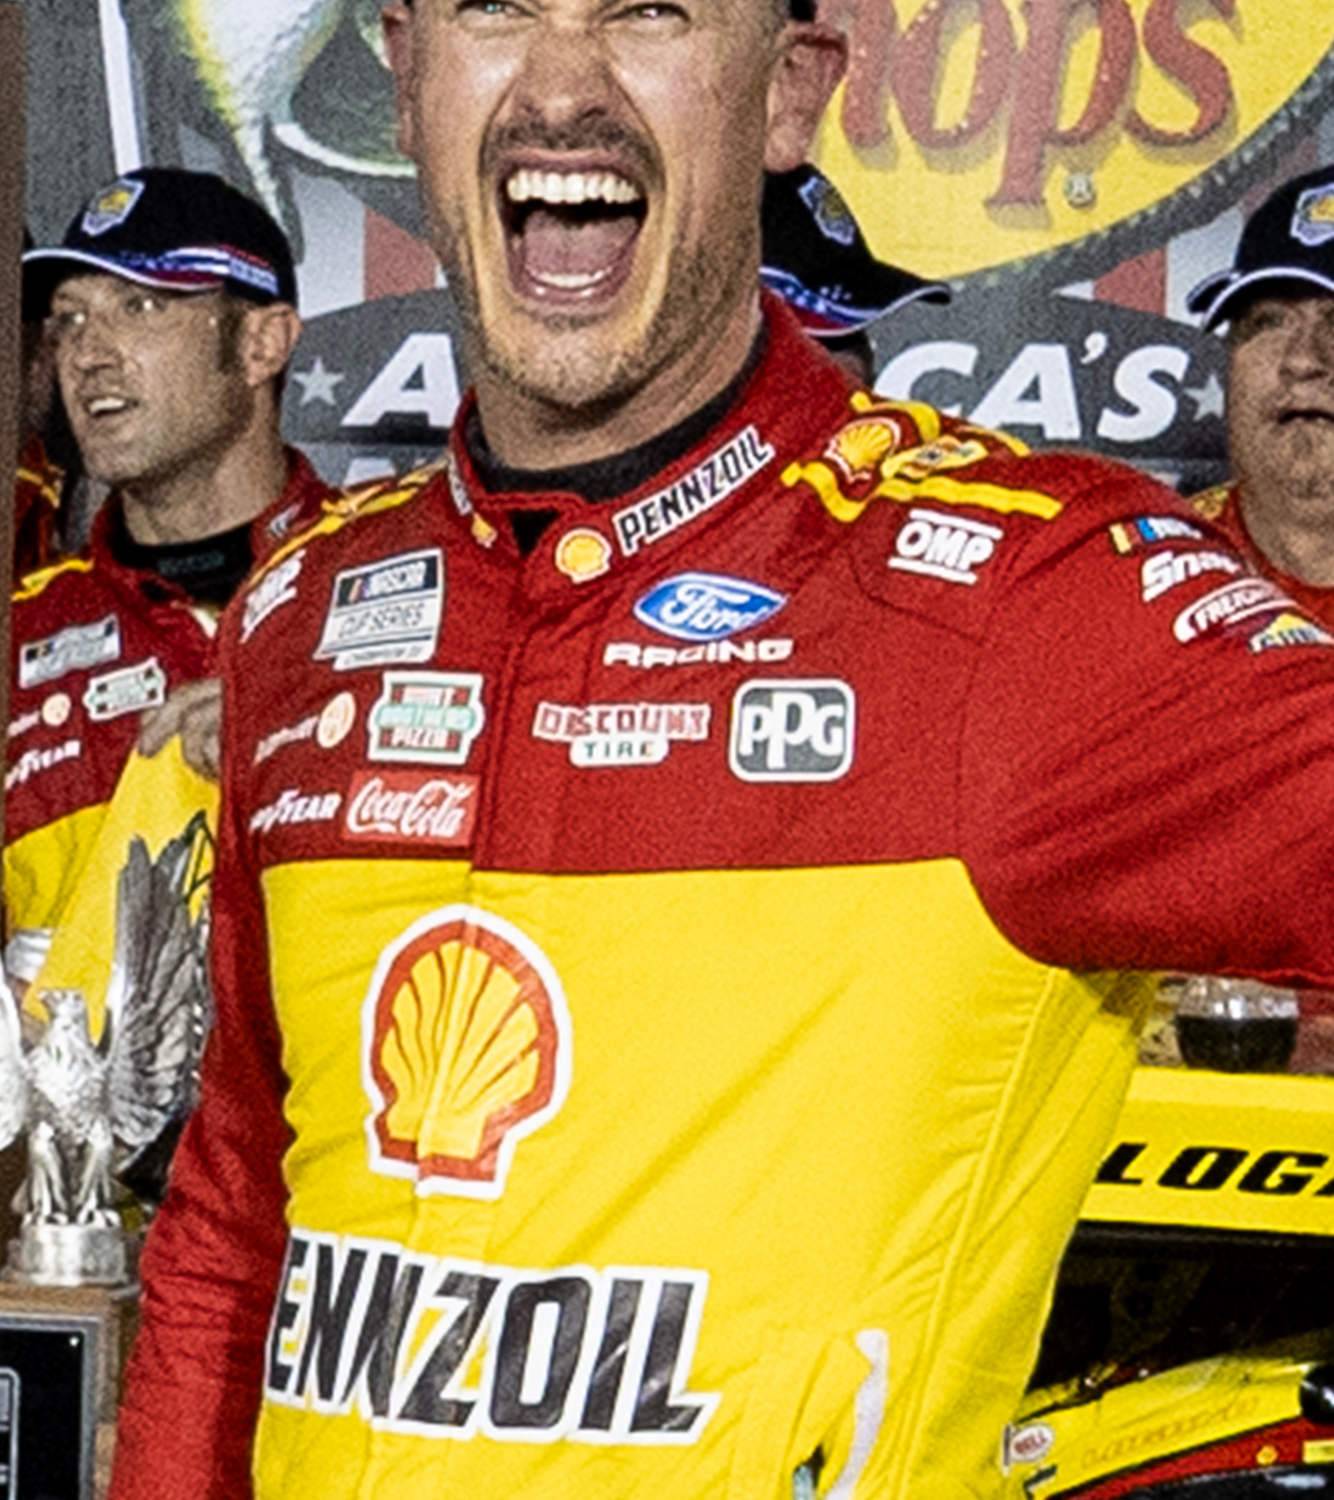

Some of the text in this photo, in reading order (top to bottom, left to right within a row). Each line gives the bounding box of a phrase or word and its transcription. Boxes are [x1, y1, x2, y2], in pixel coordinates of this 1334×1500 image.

[616, 427, 774, 554] PENNZOIL
[896, 519, 995, 571] OMP
[660, 583, 770, 630] Ford
[603, 639, 794, 670] RACING
[535, 703, 709, 740] DISCOUNT
[738, 691, 846, 770] PPG
[582, 740, 657, 761] TIRE
[347, 776, 473, 838] Coca-Cola
[267, 1235, 707, 1435] ENNZOIL
